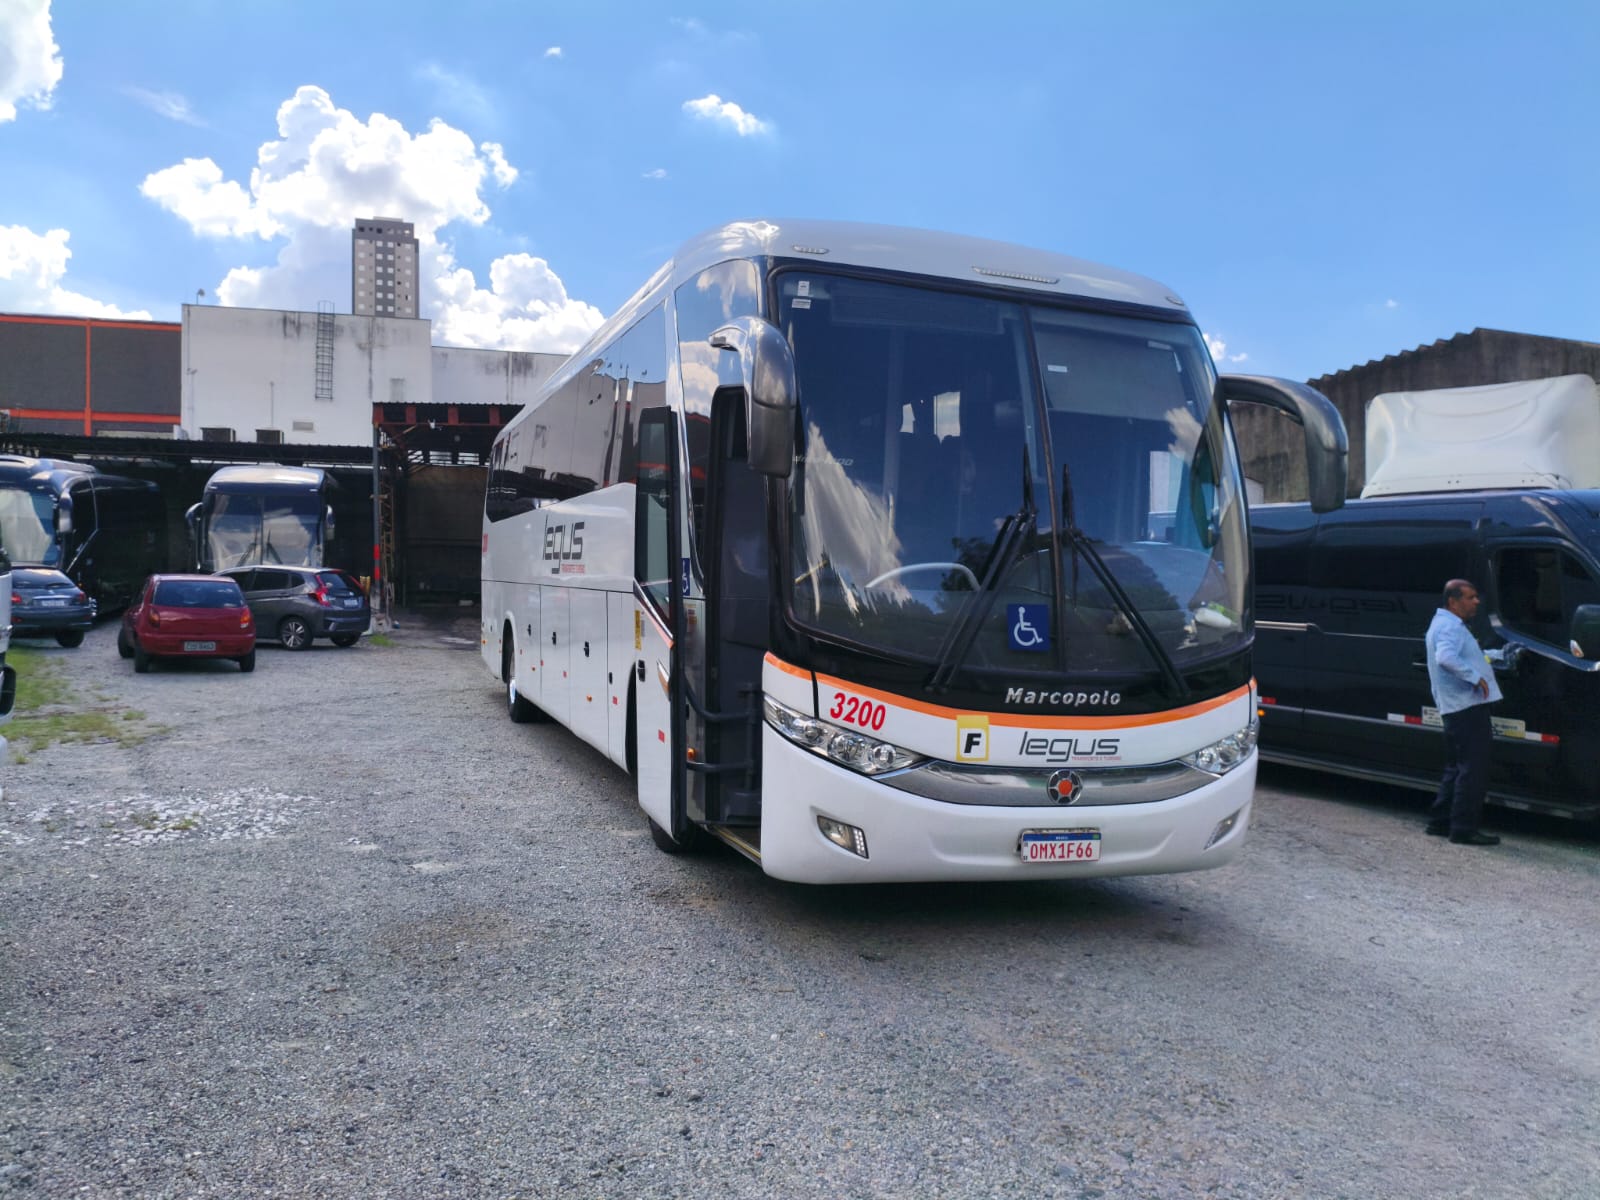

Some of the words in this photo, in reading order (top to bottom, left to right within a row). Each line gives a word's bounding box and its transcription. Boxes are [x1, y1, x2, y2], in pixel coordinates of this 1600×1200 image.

[543, 514, 585, 575] legus
[1005, 687, 1121, 707] Marcopolo
[830, 692, 886, 731] 3200
[964, 733, 981, 753] F
[1019, 731, 1120, 762] legus
[1030, 842, 1093, 859] OMX1F66
